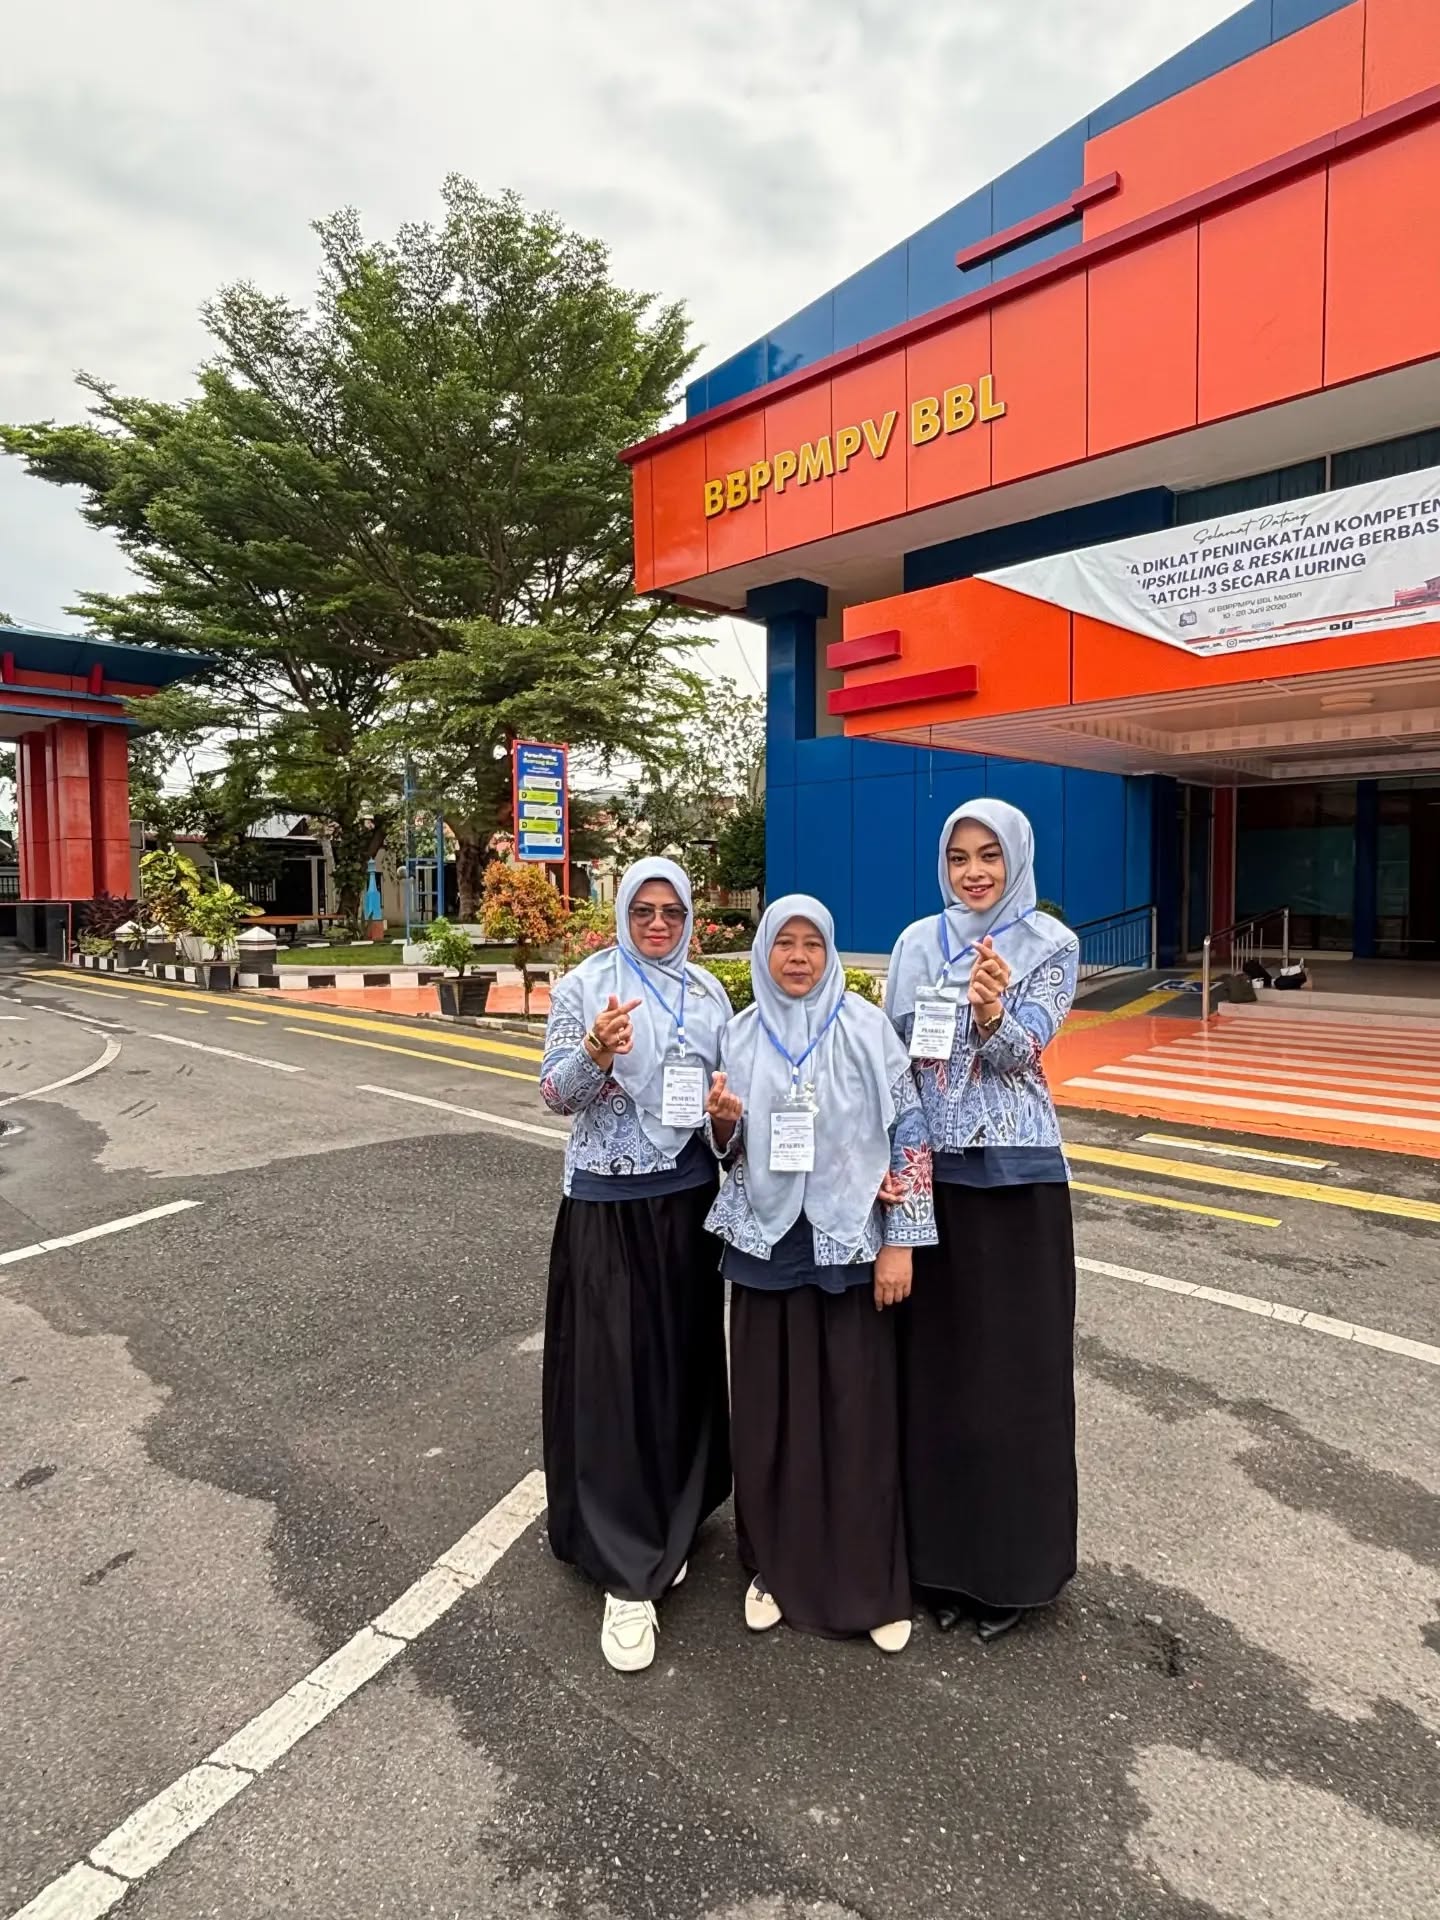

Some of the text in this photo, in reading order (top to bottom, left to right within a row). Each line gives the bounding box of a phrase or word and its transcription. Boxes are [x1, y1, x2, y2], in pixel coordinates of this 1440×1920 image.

[704, 374, 1006, 516] BBPPMPV BBL
[1193, 510, 1311, 545] Selamat Datang
[1232, 559, 1245, 572] &
[1248, 536, 1355, 569] RESKILLING
[1359, 518, 1440, 547] BERBAS
[1143, 551, 1199, 574] DIKLAT
[1202, 522, 1330, 562] PENINGKATAN
[1221, 567, 1291, 592] SECARA
[1295, 553, 1366, 578] LURING
[1247, 606, 1265, 615] Juni
[1274, 592, 1303, 601] Medan
